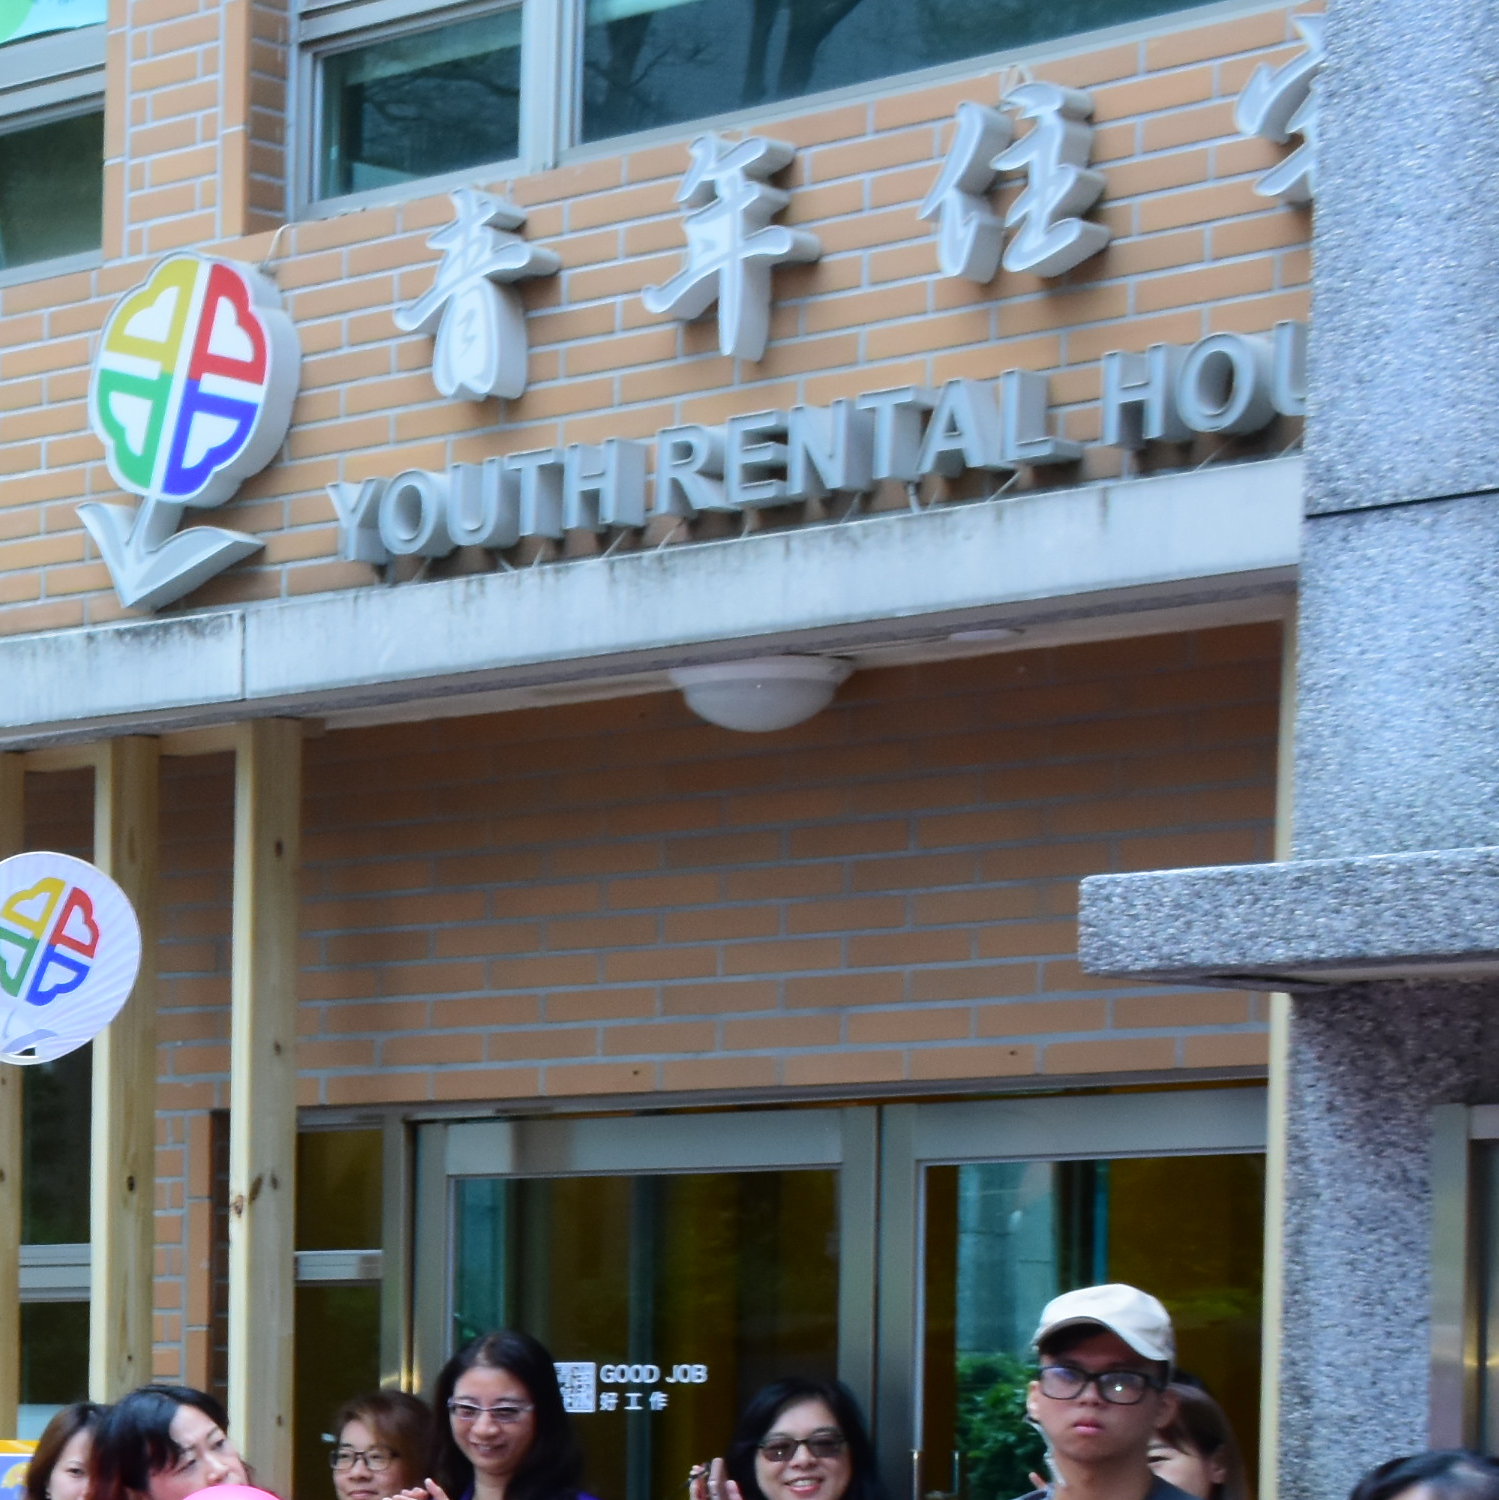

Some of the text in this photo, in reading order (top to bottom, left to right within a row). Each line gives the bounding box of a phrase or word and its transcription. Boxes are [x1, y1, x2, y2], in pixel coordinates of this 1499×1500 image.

[327, 437, 646, 563] YOUTH
[655, 369, 1083, 517] RENTAL
[600, 1364, 708, 1383] GOOD JOB
[600, 1391, 669, 1411] 好工作
